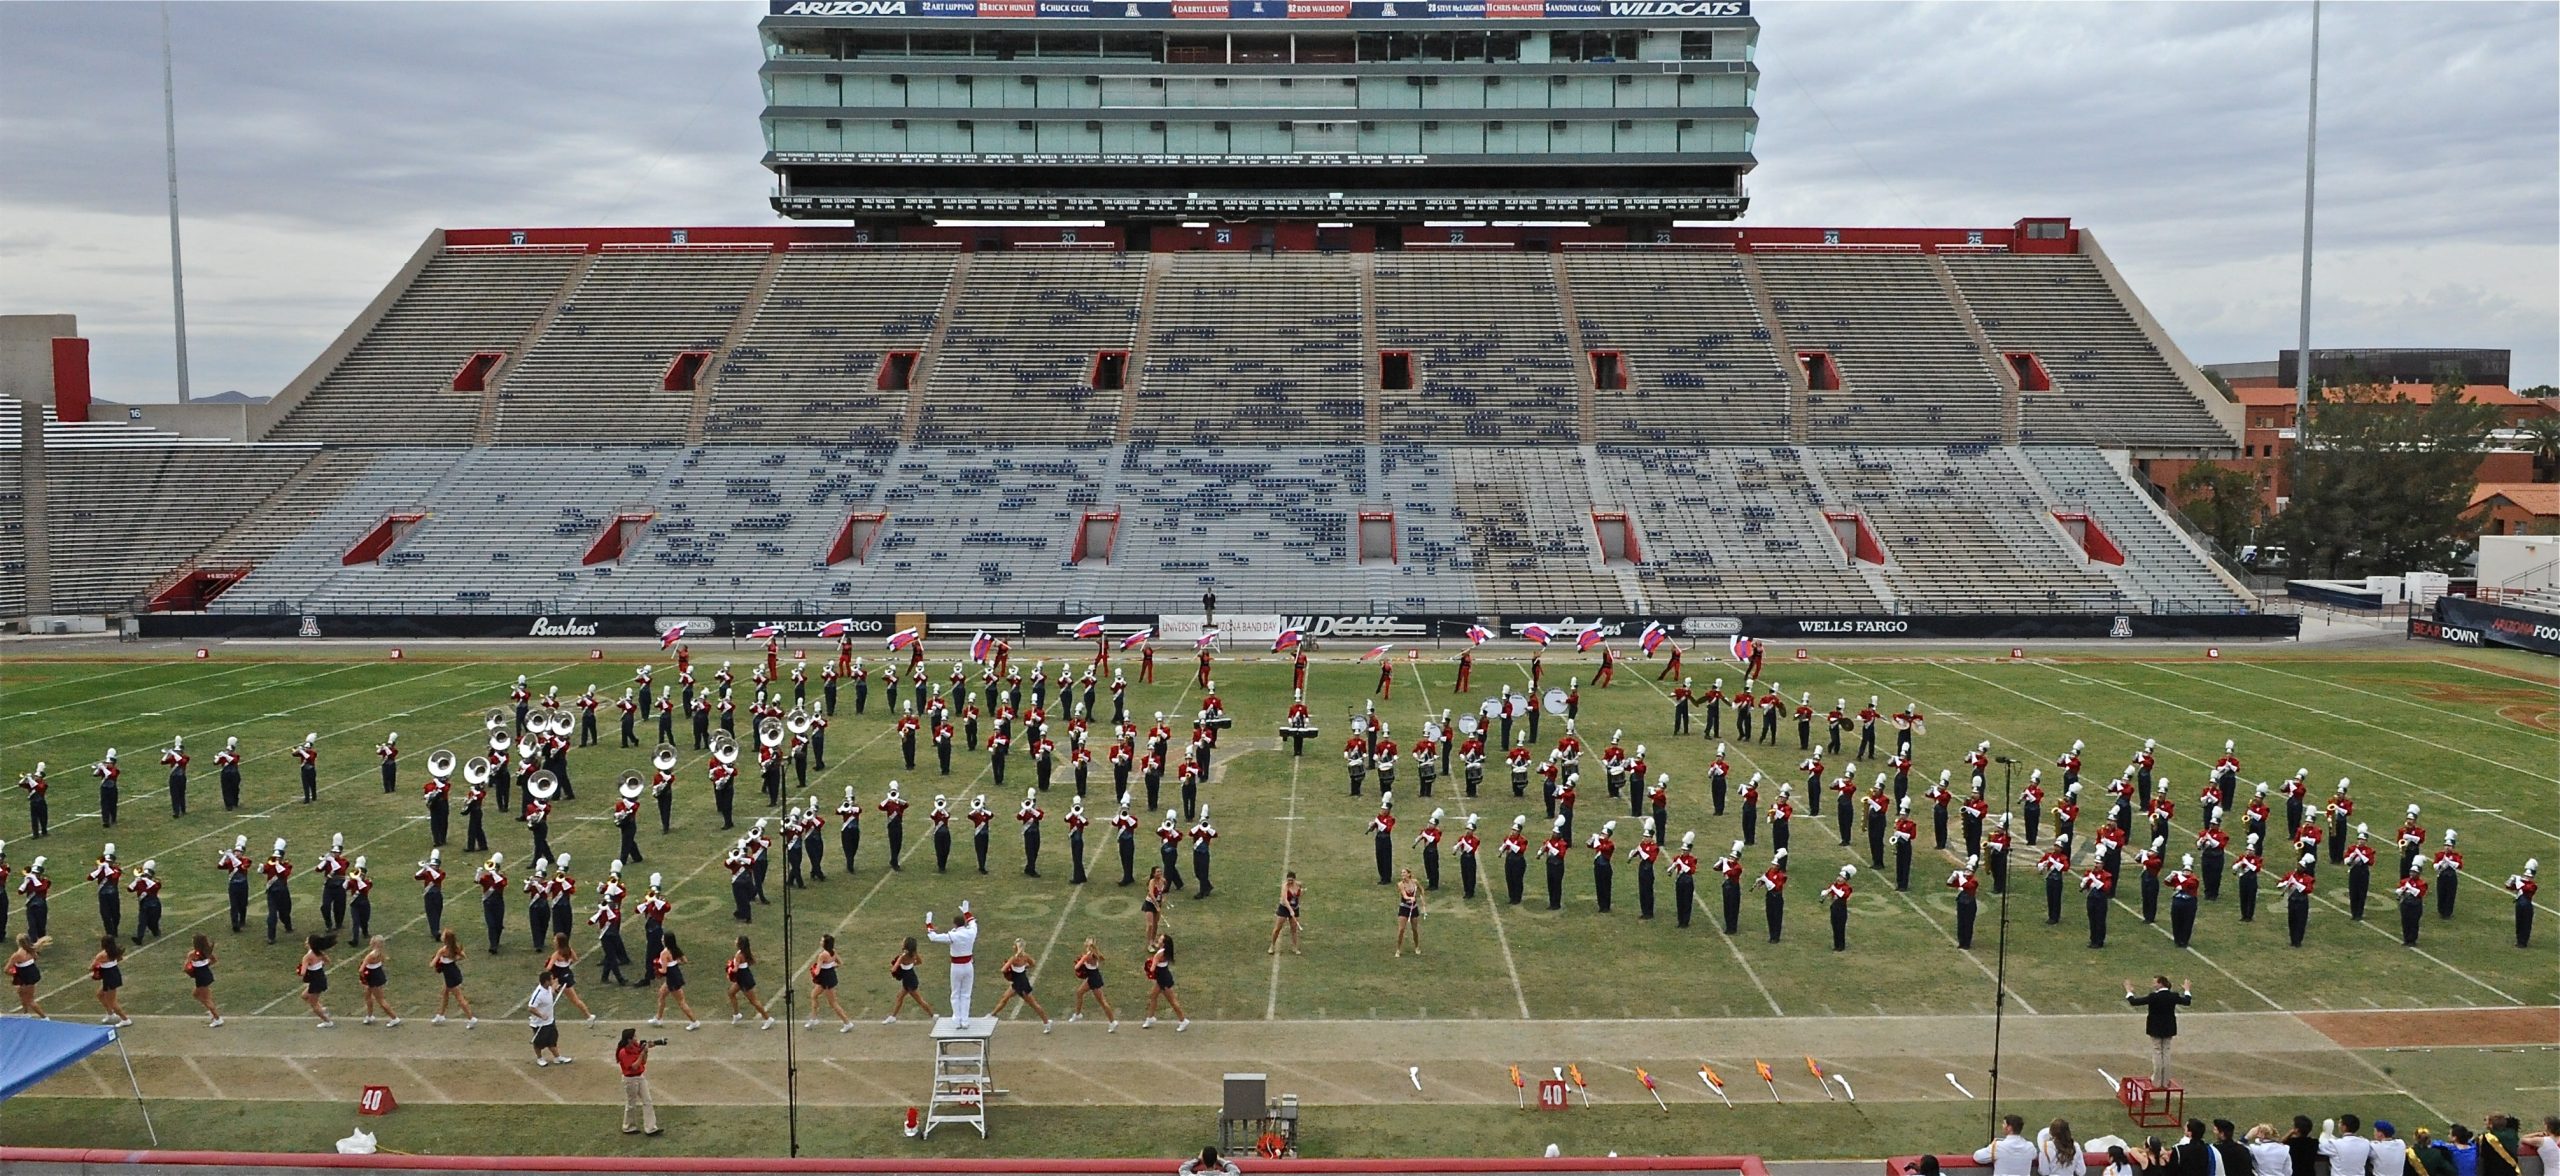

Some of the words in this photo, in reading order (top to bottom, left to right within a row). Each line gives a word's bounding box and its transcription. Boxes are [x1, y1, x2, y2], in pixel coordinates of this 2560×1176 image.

[784, 2, 906, 14] ARIZONA
[1610, 2, 1742, 16] WILDCATS
[674, 235, 685, 244] 18
[857, 234, 868, 242] 19
[1062, 234, 1075, 242] 20
[1218, 234, 1229, 242] 21
[1451, 234, 1464, 242] 22
[1657, 234, 1670, 243] 23
[1825, 235, 1838, 244] 24
[1968, 236, 1981, 245] 25
[130, 409, 140, 417] 16
[529, 617, 598, 636] Bashas'
[850, 621, 882, 631] RGO
[1163, 622, 1198, 632] UNIVERSITY
[1243, 622, 1261, 631] BAND
[1264, 622, 1277, 631] DAY
[1799, 621, 1852, 632] WELLS
[1856, 621, 1907, 632] FARGO
[2533, 624, 2560, 640] FOO
[998, 894, 1142, 919] 50
[362, 1090, 382, 1110] 40
[1543, 1085, 1562, 1105] 40
